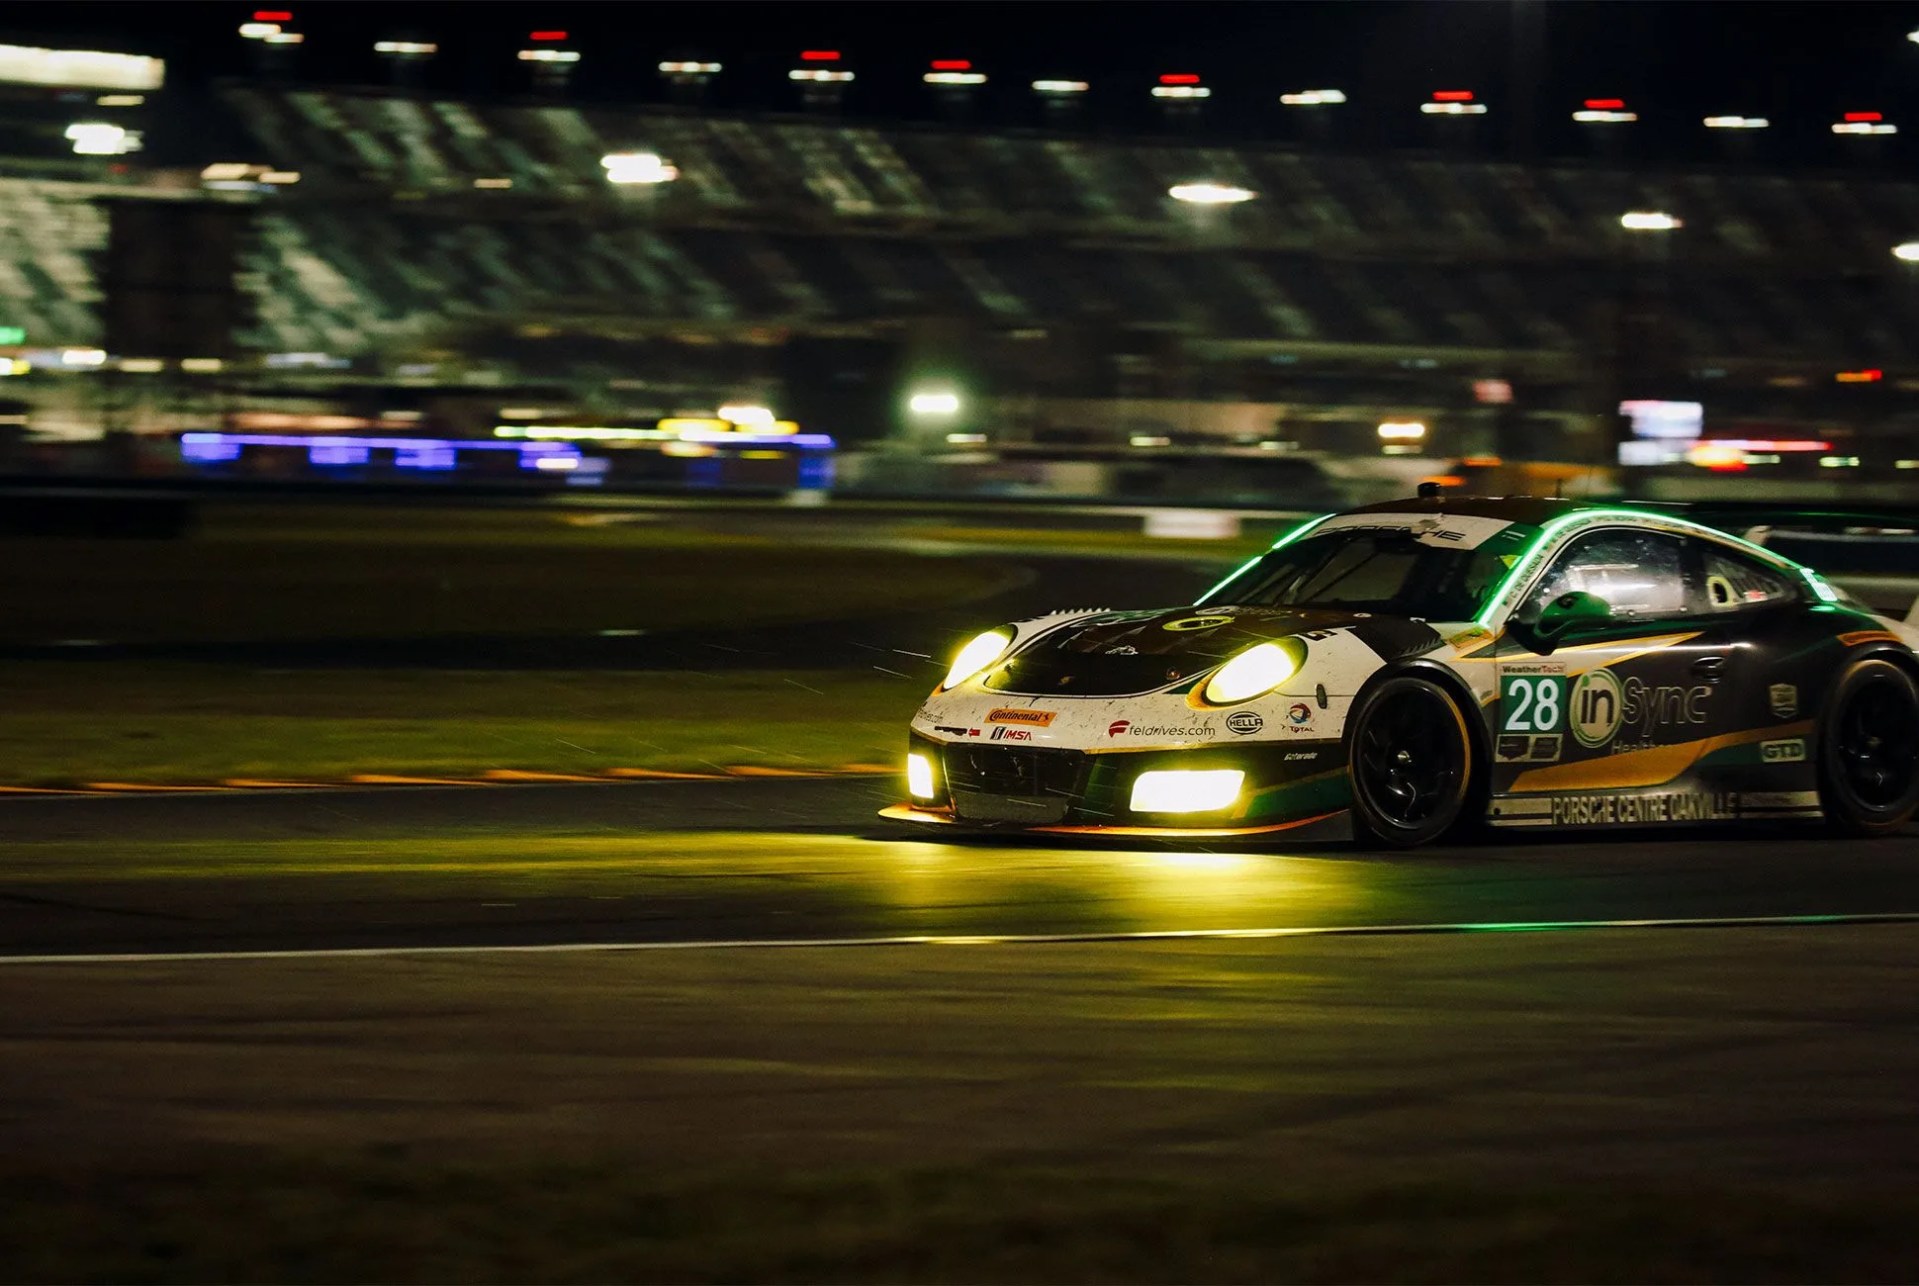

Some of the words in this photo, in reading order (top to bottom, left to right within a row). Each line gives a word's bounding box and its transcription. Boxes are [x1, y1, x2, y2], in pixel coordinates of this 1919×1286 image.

[1503, 665, 1563, 673] WeatherTech
[1505, 678, 1559, 730] 28
[989, 709, 1042, 722] Continental
[1229, 717, 1264, 728] HELLA
[1003, 729, 1032, 742] IMSA
[1128, 724, 1216, 737] feldrives.com
[1289, 726, 1315, 734] TOTAL
[1763, 742, 1802, 759] GTD
[1552, 795, 1616, 825] PORSCHE
[1616, 794, 1668, 823] CENTRE
[1669, 791, 1739, 821] OAKVILLE
